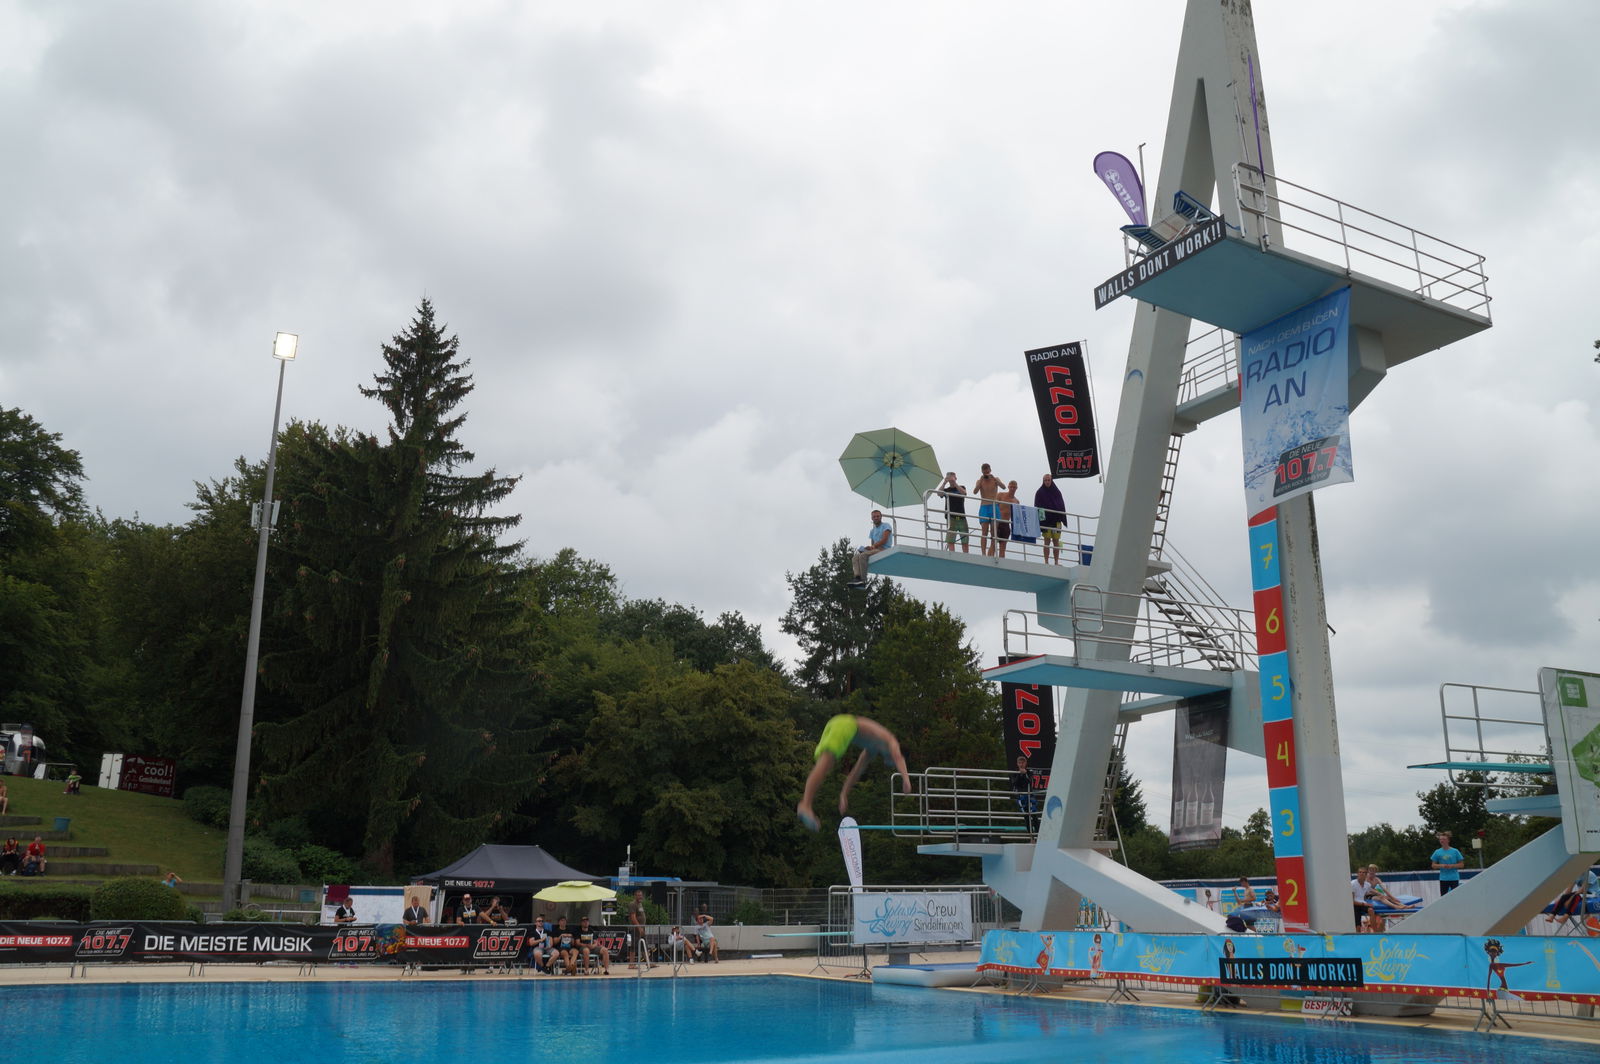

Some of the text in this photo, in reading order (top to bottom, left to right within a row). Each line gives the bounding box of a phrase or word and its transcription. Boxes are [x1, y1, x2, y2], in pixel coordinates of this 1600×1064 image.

[1098, 222, 1222, 303] WALLS DONT WORK!!
[1248, 337, 1275, 356] NACH
[1302, 307, 1338, 331] BADEN
[1030, 347, 1077, 363] RADIO AN!
[1247, 327, 1336, 389] RADIO
[1263, 371, 1307, 414] AN
[1044, 365, 1081, 445] 107.7
[1289, 441, 1323, 458] DIE NEUE
[1057, 455, 1093, 469] 107.7
[1274, 445, 1338, 484] 107.7
[1260, 543, 1273, 569] 7
[1265, 608, 1280, 634] 6
[1271, 675, 1285, 701] 5
[1276, 740, 1290, 767] 4
[1280, 809, 1294, 836] 3
[1285, 879, 1299, 906] 2
[927, 899, 957, 917] Crew
[914, 917, 964, 934] Sindelfingen
[0, 937, 71, 945] DIE NEUE 107.7
[80, 935, 131, 949] 107.7
[144, 935, 313, 952] DIE MEISTE MUSIK
[332, 936, 376, 952] 107.
[417, 938, 442, 946] NEUE
[444, 938, 467, 946] 107.7
[477, 936, 525, 951] 107.7
[596, 938, 625, 950] 07.7
[1224, 963, 1358, 982] WALLS DONT WORK!!
